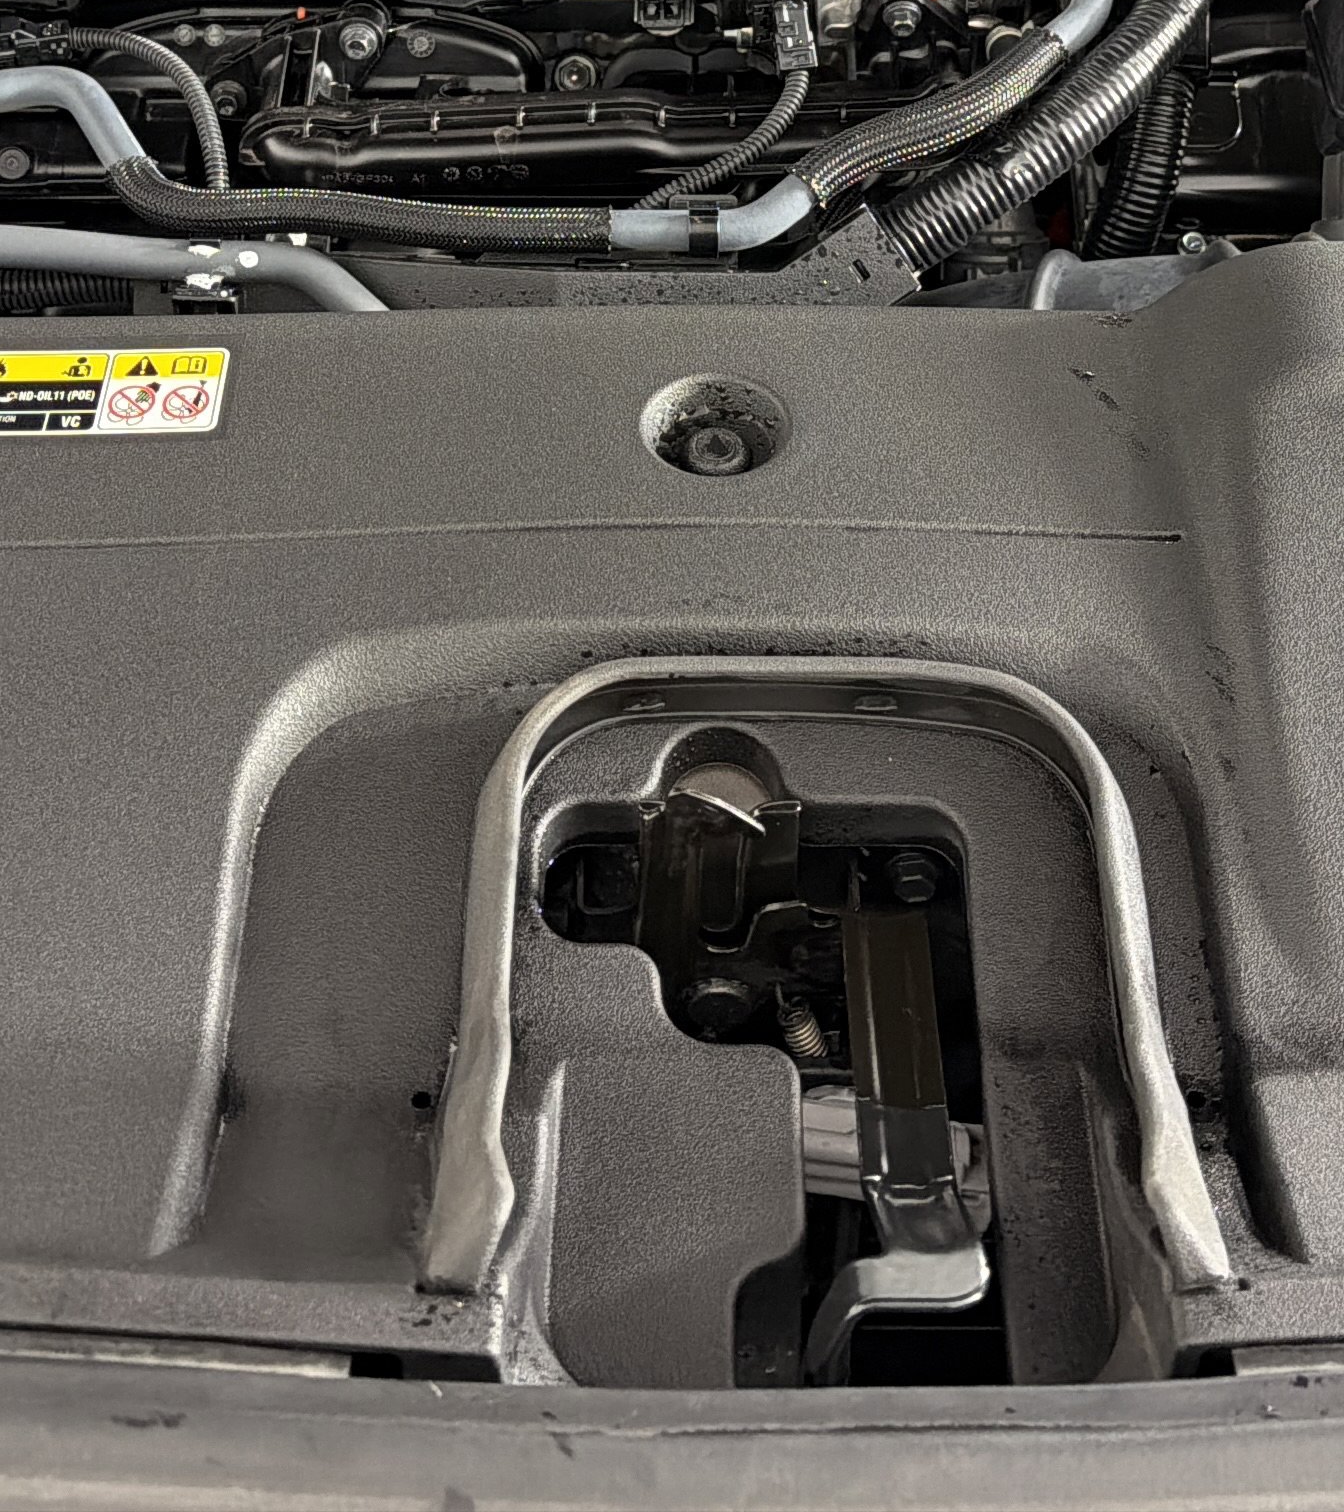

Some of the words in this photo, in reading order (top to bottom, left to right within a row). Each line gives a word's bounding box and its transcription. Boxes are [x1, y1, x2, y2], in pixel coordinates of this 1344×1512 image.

[19, 390, 65, 401] ND-OIL11
[67, 390, 96, 402] (POE)
[61, 415, 82, 428] VC
